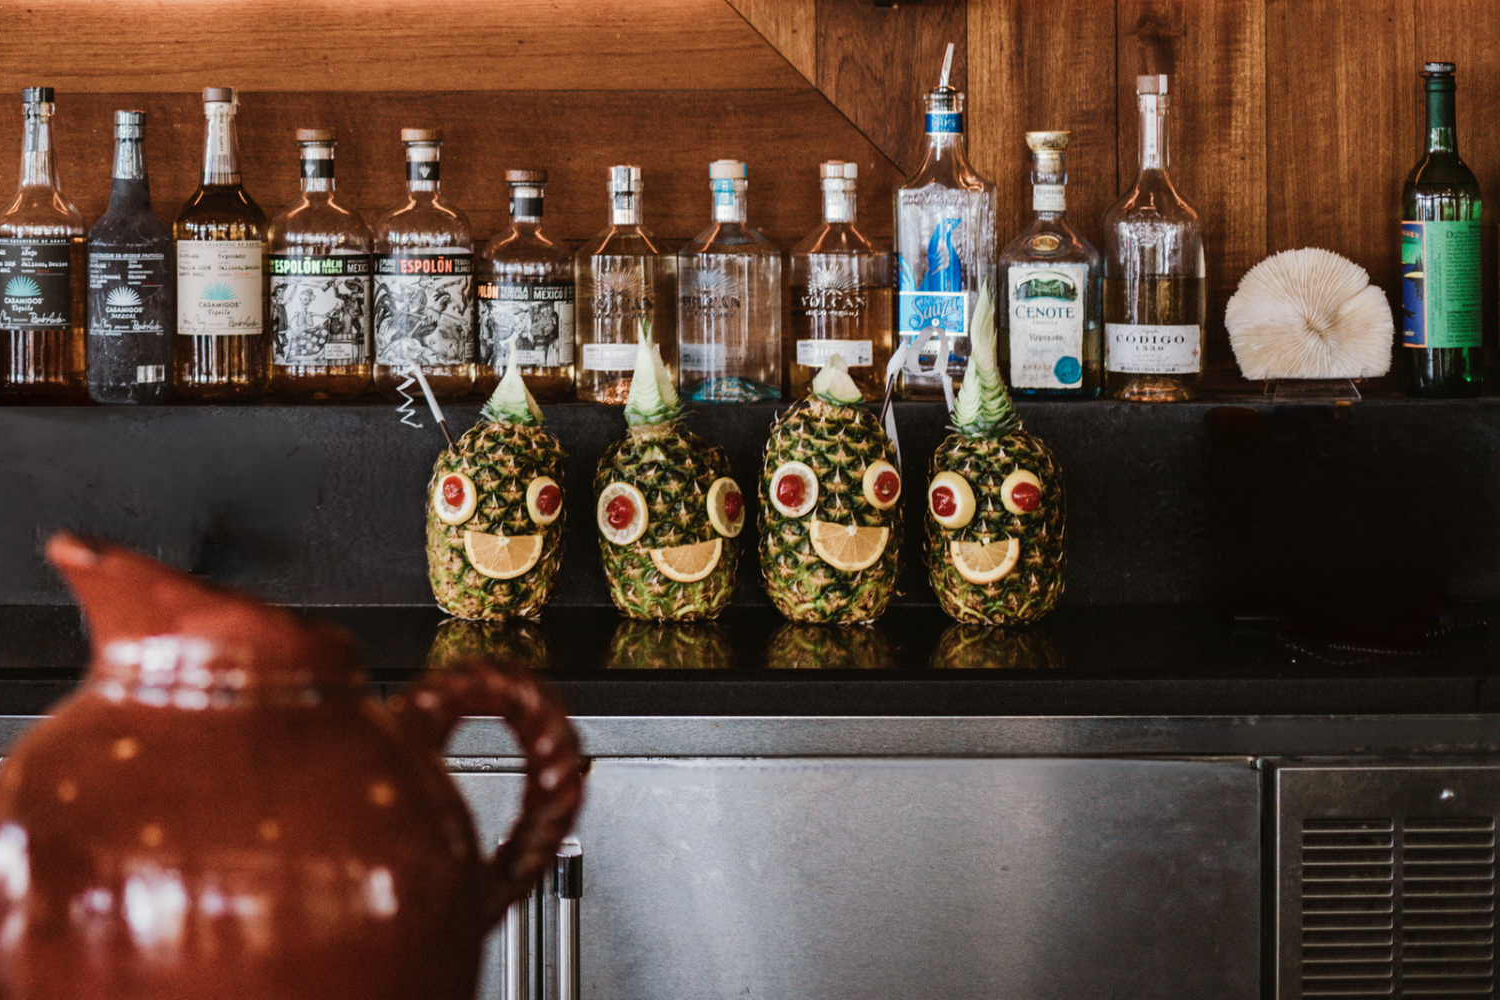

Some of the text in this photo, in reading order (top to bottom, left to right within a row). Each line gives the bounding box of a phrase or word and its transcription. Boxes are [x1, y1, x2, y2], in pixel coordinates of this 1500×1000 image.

[322, 258, 342, 268] AÑEJO
[534, 289, 564, 300] MEXICO
[12, 304, 34, 313] Tequila
[589, 298, 654, 310] VOLCAN
[801, 296, 866, 310] VOLCAN
[908, 296, 960, 328] Sauza
[1015, 305, 1074, 319] CENOTE
[1030, 333, 1063, 342] Reposado
[1116, 332, 1184, 344] CÓDIGO
